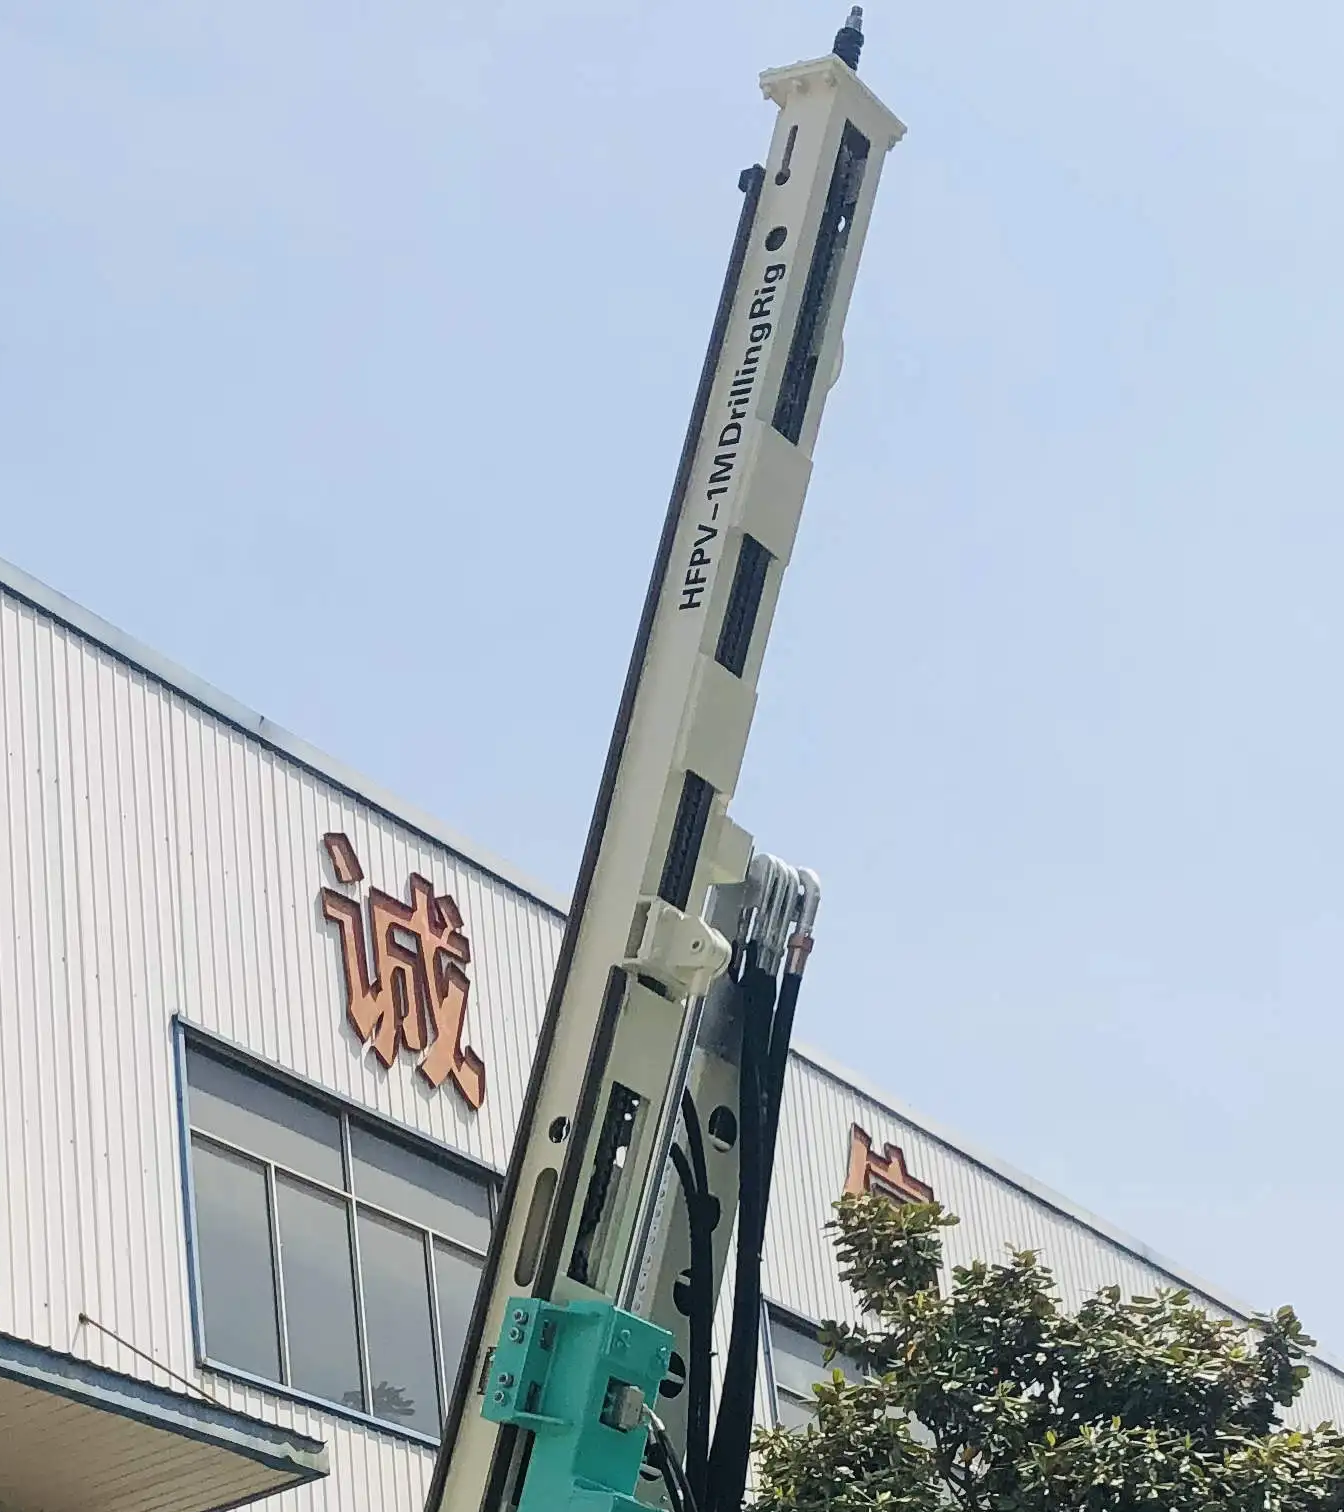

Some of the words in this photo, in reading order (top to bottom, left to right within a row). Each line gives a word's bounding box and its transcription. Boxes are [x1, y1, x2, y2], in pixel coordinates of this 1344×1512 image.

[679, 452, 757, 611] HFPV-1M
[718, 321, 772, 447] Drilling
[749, 262, 786, 320] Rig
[322, 832, 486, 1111] 诚
